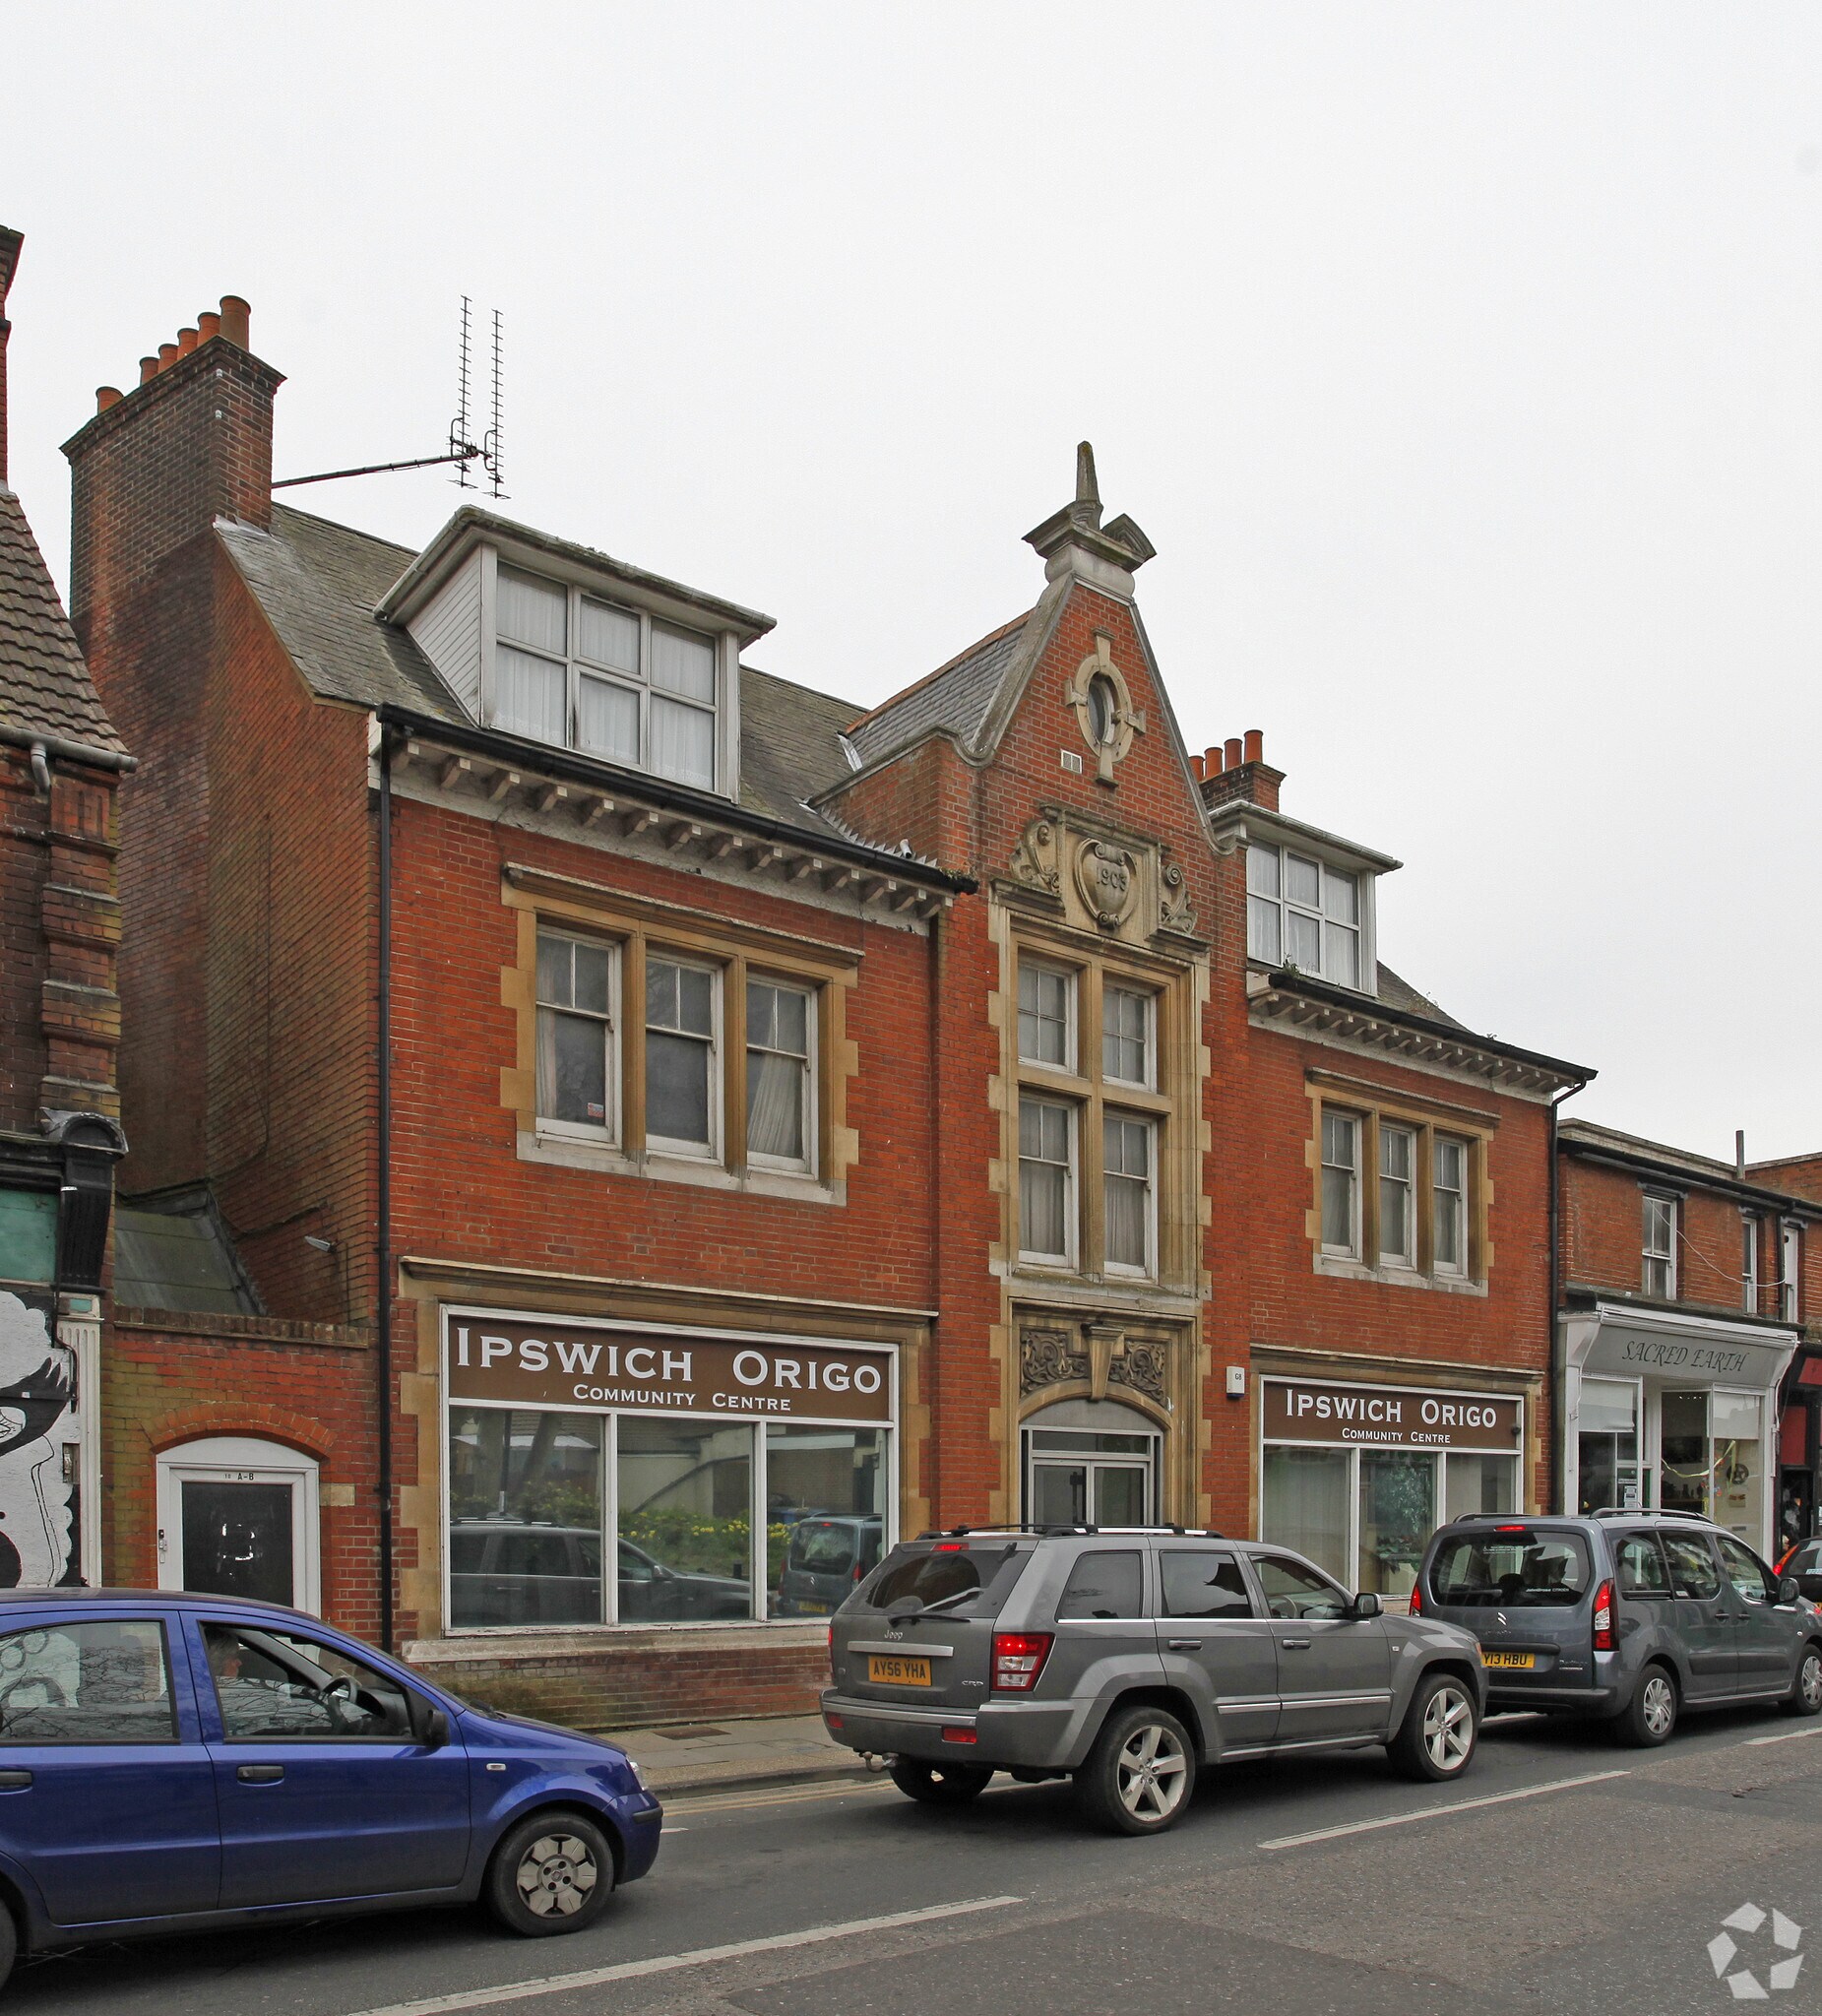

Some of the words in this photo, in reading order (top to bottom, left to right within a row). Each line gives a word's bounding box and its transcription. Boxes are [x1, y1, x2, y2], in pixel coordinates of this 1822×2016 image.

[456, 1326, 693, 1382] IPSWICH
[732, 1350, 882, 1394] ORIGO
[1622, 1341, 1688, 1366] SACRED
[1690, 1349, 1750, 1373] EARTH
[573, 1384, 696, 1406] COMMUNITY
[712, 1392, 791, 1411] CENTRE
[1286, 1389, 1402, 1423] IPSWICH
[1420, 1399, 1497, 1427] ORIGO
[1342, 1427, 1403, 1442] COMMUNITY
[1410, 1431, 1451, 1444] CENTRE
[884, 1629, 904, 1641] Jeep
[873, 1661, 902, 1677] AY56
[904, 1663, 926, 1679] YHA
[1483, 1654, 1501, 1665] Y13
[1503, 1654, 1528, 1666] HBU
